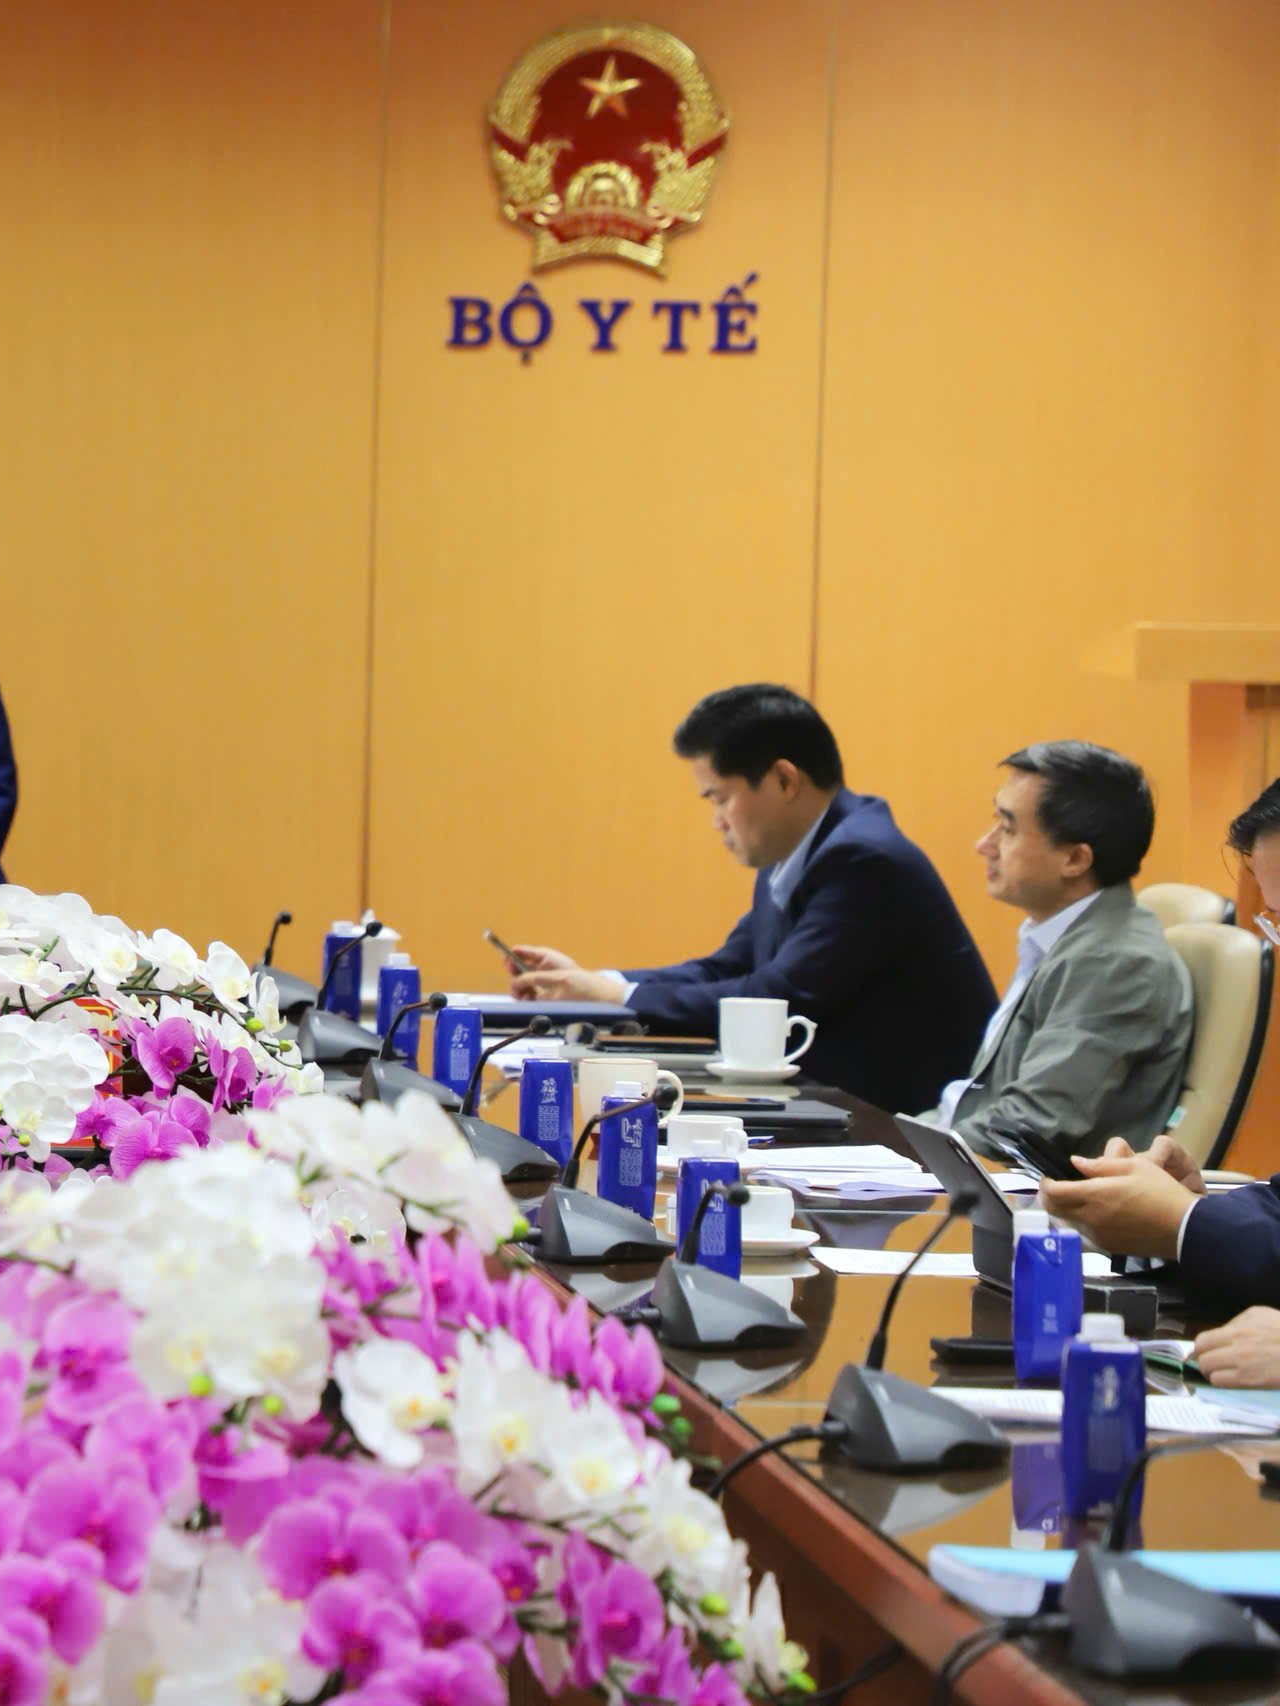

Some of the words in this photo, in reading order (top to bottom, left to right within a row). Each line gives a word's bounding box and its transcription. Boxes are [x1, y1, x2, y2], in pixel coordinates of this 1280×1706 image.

[446, 281, 553, 366] BỘ
[579, 299, 631, 352] Y
[652, 271, 758, 354] TẾ
